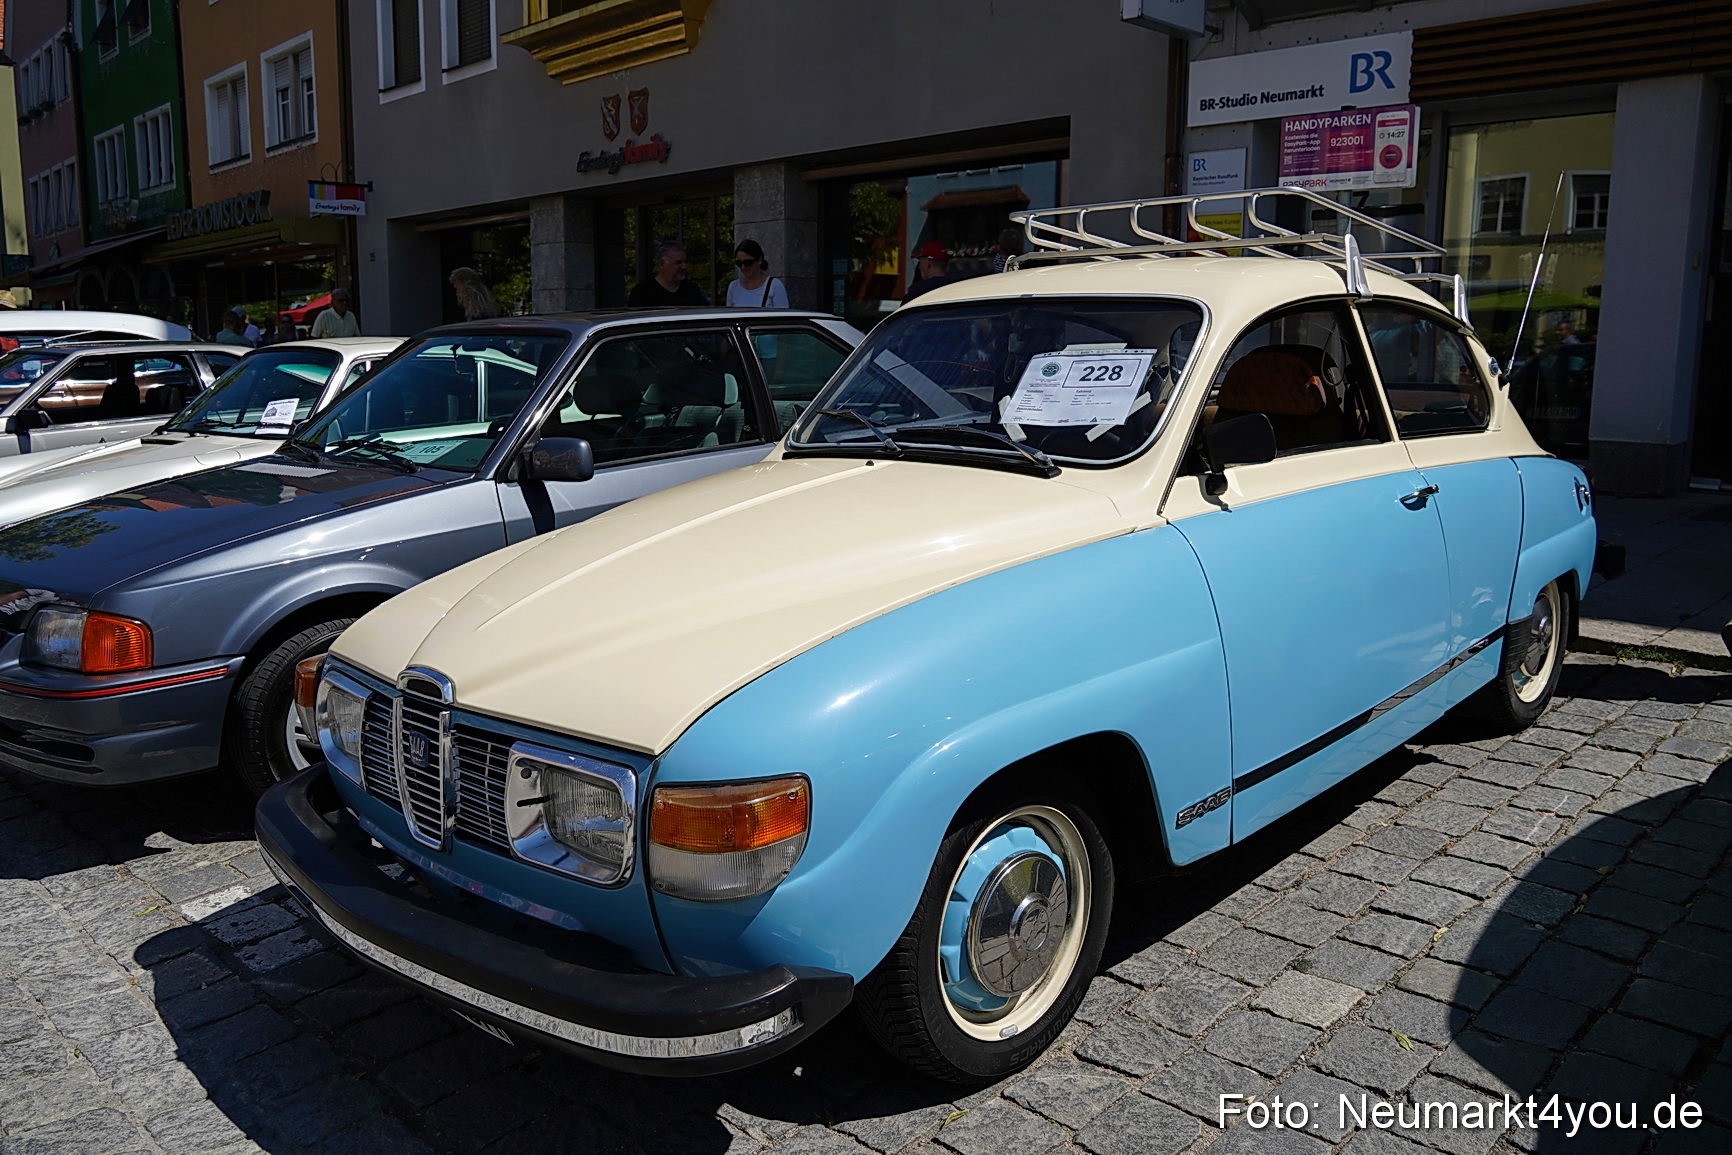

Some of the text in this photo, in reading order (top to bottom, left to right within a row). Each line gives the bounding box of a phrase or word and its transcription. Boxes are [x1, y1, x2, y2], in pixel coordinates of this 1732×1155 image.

[1349, 50, 1396, 94] BR
[1200, 85, 1325, 112] BR-Studio Neumarkt
[1285, 114, 1371, 132] HANDYPARKEN
[1330, 135, 1365, 147] 923001
[1387, 131, 1405, 139] 14:27
[1193, 158, 1207, 172] BR
[340, 203, 361, 213] family
[1078, 364, 1124, 382] 228
[1178, 787, 1232, 825] SAAB
